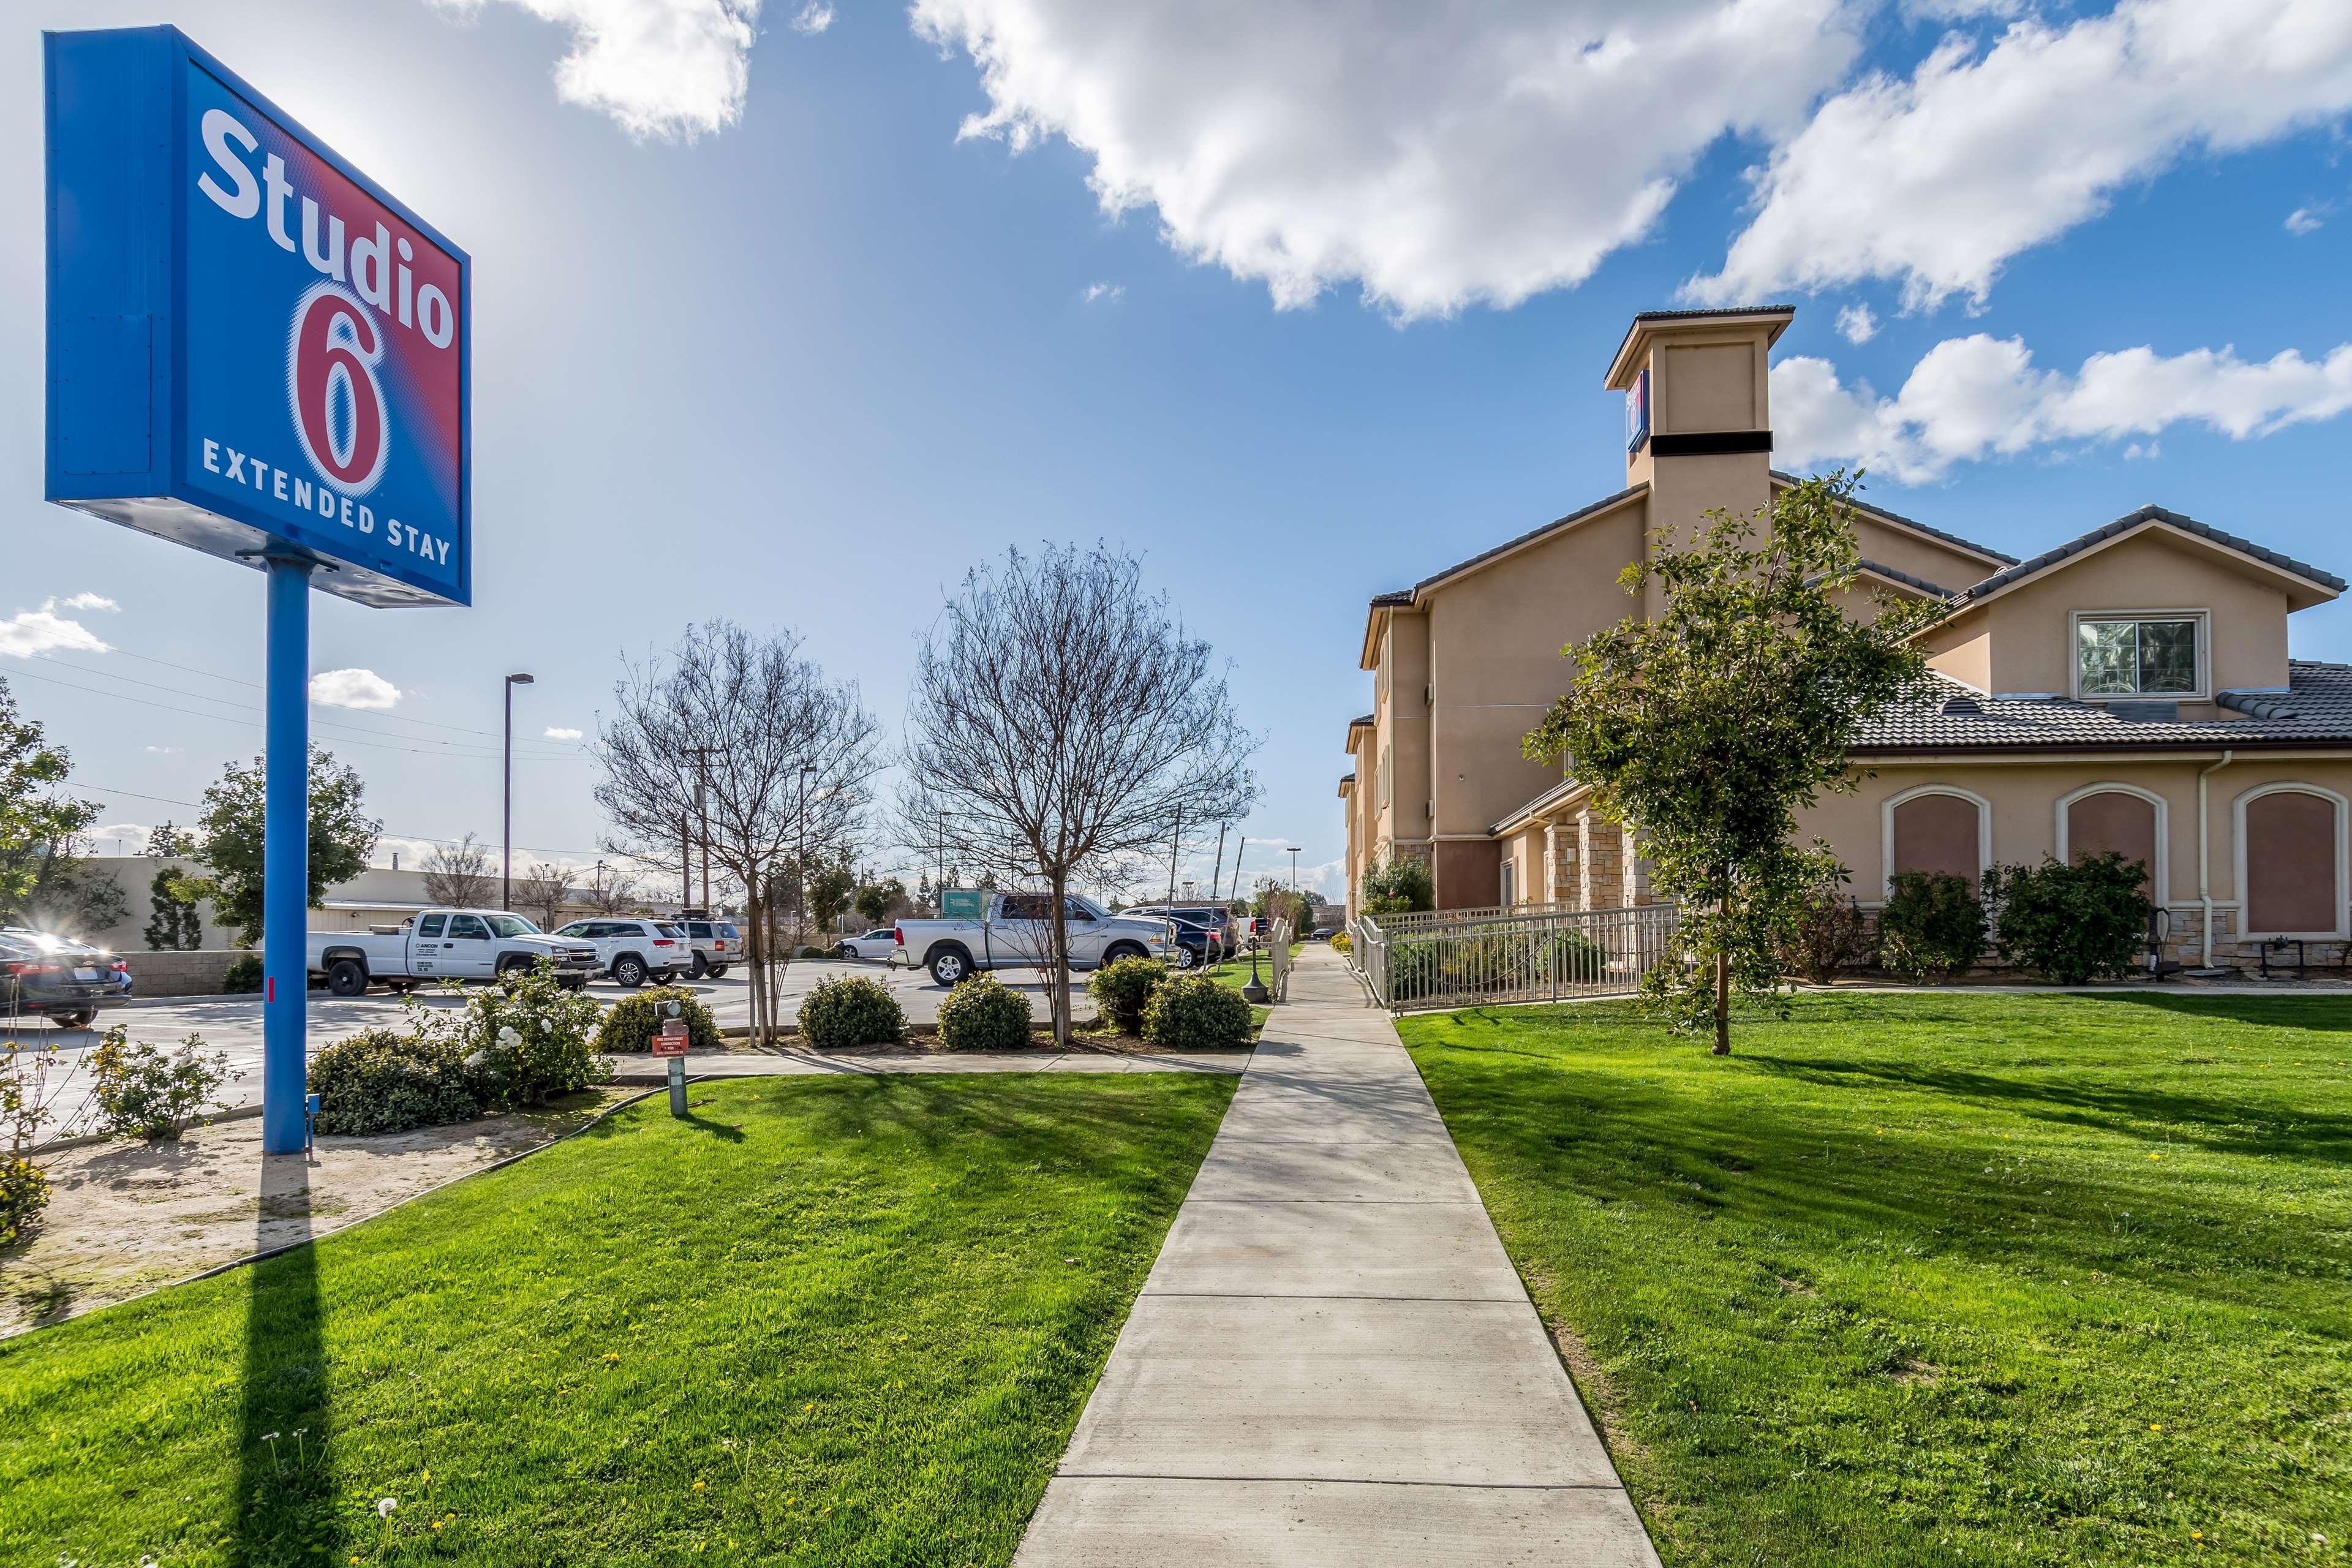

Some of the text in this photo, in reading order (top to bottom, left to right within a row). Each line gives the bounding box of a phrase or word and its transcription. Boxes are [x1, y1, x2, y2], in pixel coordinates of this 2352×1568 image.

[197, 108, 454, 349] Studio
[295, 293, 382, 484] 6
[203, 437, 451, 566] EXTENDED STAY
